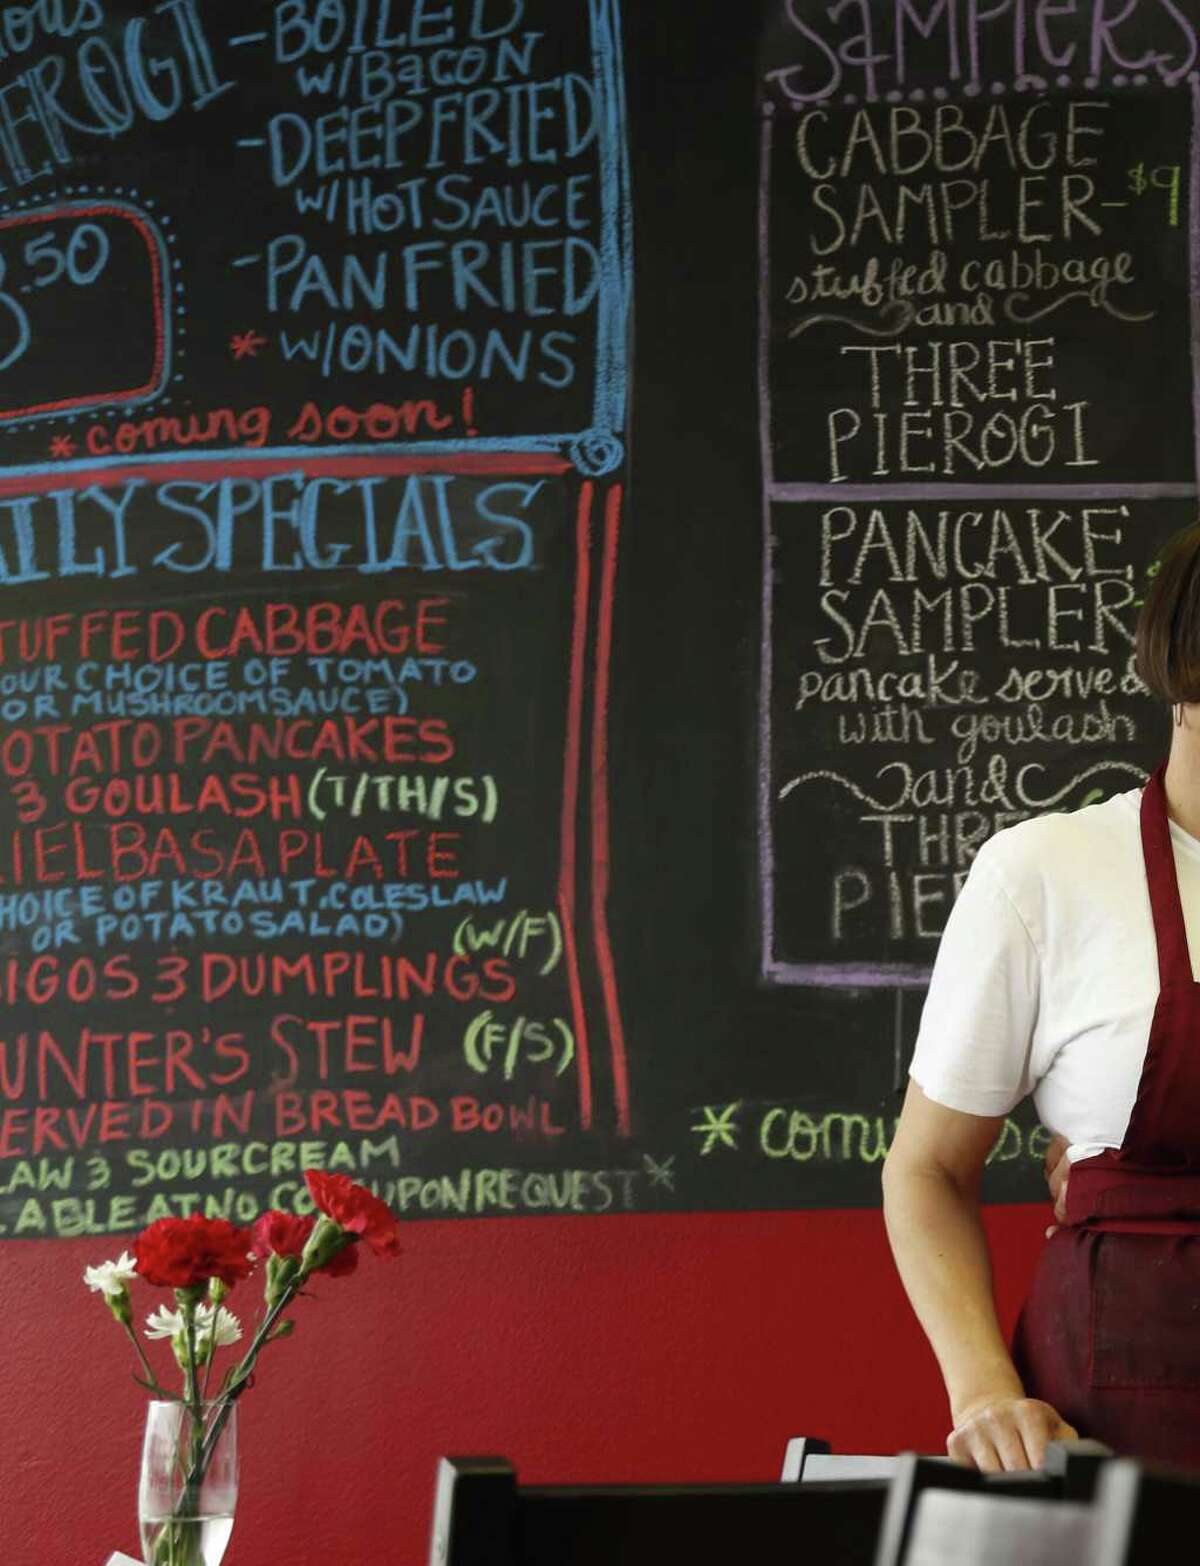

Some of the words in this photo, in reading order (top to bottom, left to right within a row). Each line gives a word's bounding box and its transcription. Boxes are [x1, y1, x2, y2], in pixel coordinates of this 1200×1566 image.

[797, 101, 1109, 180] CABBAGE
[401, 237, 601, 316] FRIED
[961, 248, 1134, 306] cabbage
[914, 291, 996, 327] and
[841, 337, 1056, 407] THREE
[86, 404, 270, 457] coming
[827, 400, 1098, 483] PIEROGI
[819, 503, 1134, 587] PANCAKE
[196, 598, 452, 660] CABBAGE
[813, 579, 1137, 664] SAMPLER
[75, 659, 228, 696] CHOICE
[244, 657, 284, 686] OF
[308, 656, 476, 688] TOMATO
[795, 654, 988, 710] pancake
[173, 716, 454, 766] PANCAKES
[838, 704, 934, 744] with
[950, 703, 1136, 764] goulash
[64, 774, 300, 822] GOULASH
[0, 821, 264, 886] IELBASA
[279, 829, 461, 879] PLATE
[32, 917, 81, 952] OR
[96, 908, 243, 947] POTATO
[112, 880, 163, 922] OF
[202, 952, 517, 1002] DUMPLINGS
[271, 1013, 424, 1090] STEW
[190, 1091, 253, 1138] IN
[275, 1095, 440, 1137] BREAD
[452, 1094, 566, 1135] BOWL
